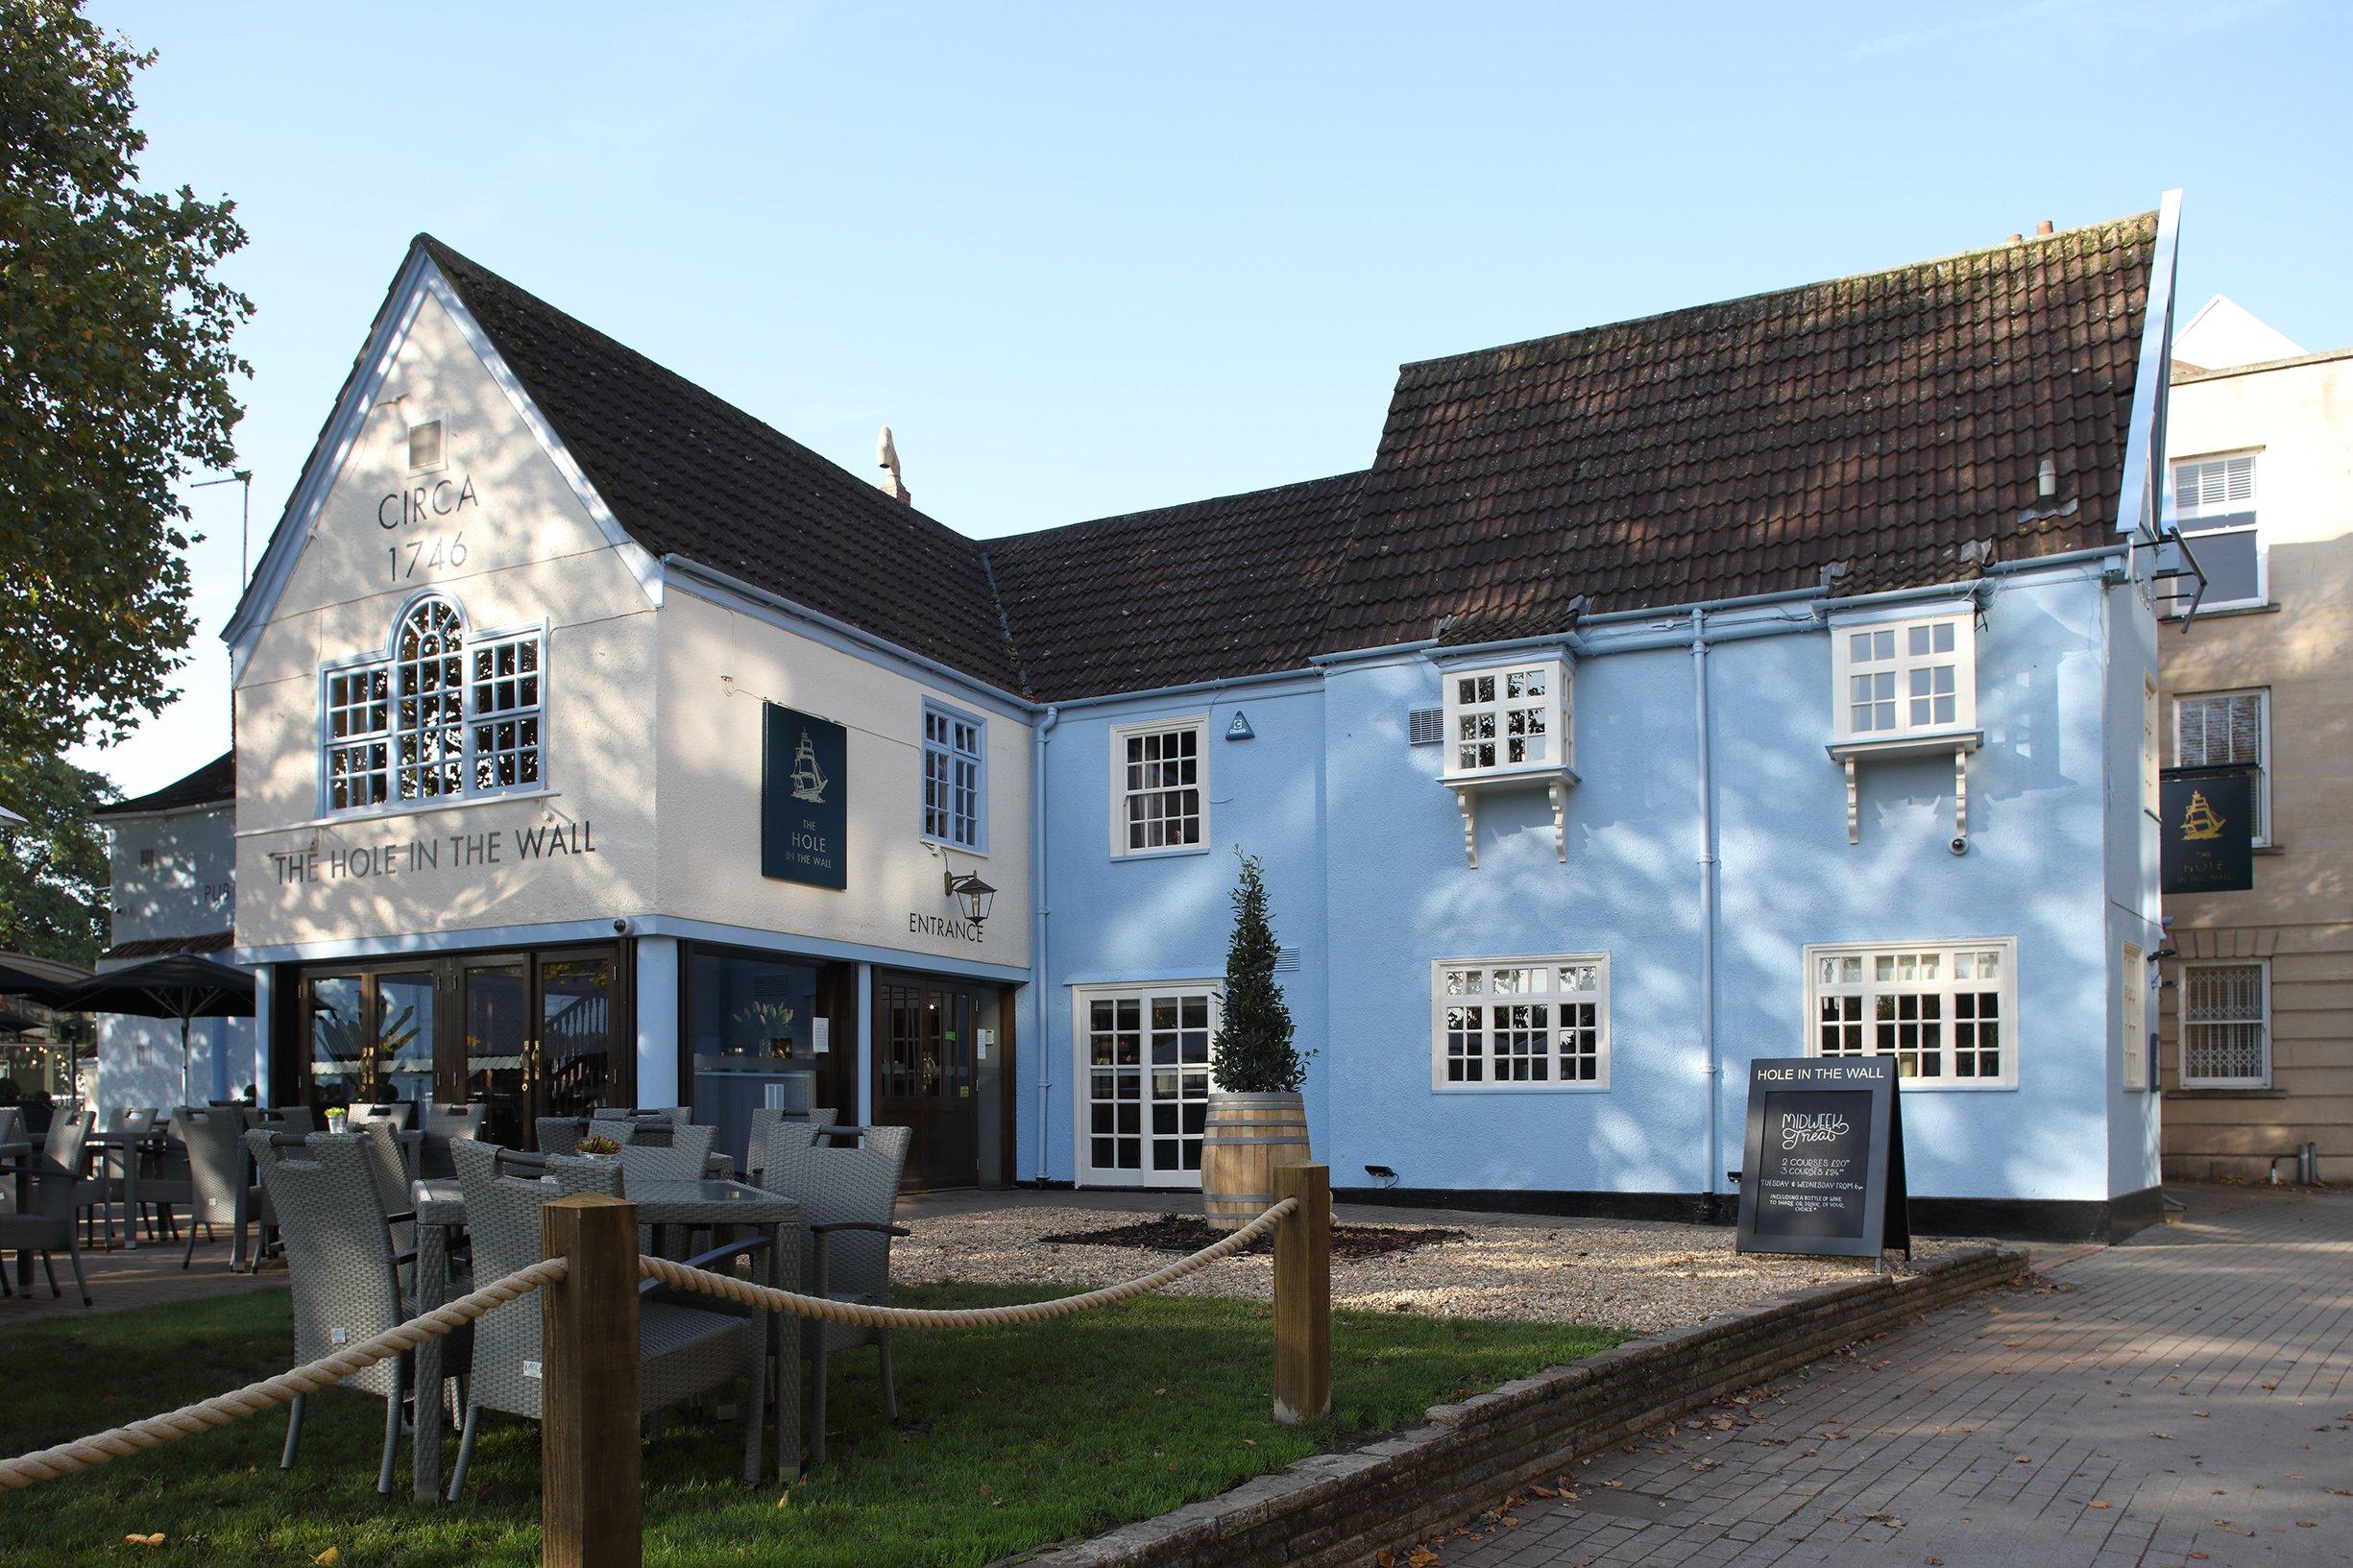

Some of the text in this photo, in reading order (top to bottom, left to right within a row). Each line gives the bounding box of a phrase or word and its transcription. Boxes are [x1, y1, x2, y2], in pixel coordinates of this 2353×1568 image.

[378, 474, 478, 529] CIRCA
[389, 531, 468, 582] 1746
[803, 819, 816, 831] THE
[276, 821, 595, 884] THE HOLE IN THE WALL
[791, 832, 826, 853] HOLE
[786, 852, 832, 868] IN THE WALL
[205, 883, 230, 902] PUB
[910, 912, 983, 943] ENTRANCE
[1758, 1067, 1884, 1080] HOLE IN THE WALL
[1782, 1113, 1850, 1135] MIDWEEK
[1782, 1127, 1836, 1150] Treat
[1781, 1167, 1788, 1175] 3
[1788, 1168, 1824, 1177] COURSES
[1782, 1157, 1788, 1167] 2
[1790, 1158, 1829, 1168] COURSES
[1760, 1179, 1790, 1188] TUESDAY
[1797, 1181, 1834, 1190] WEDNESDAY
